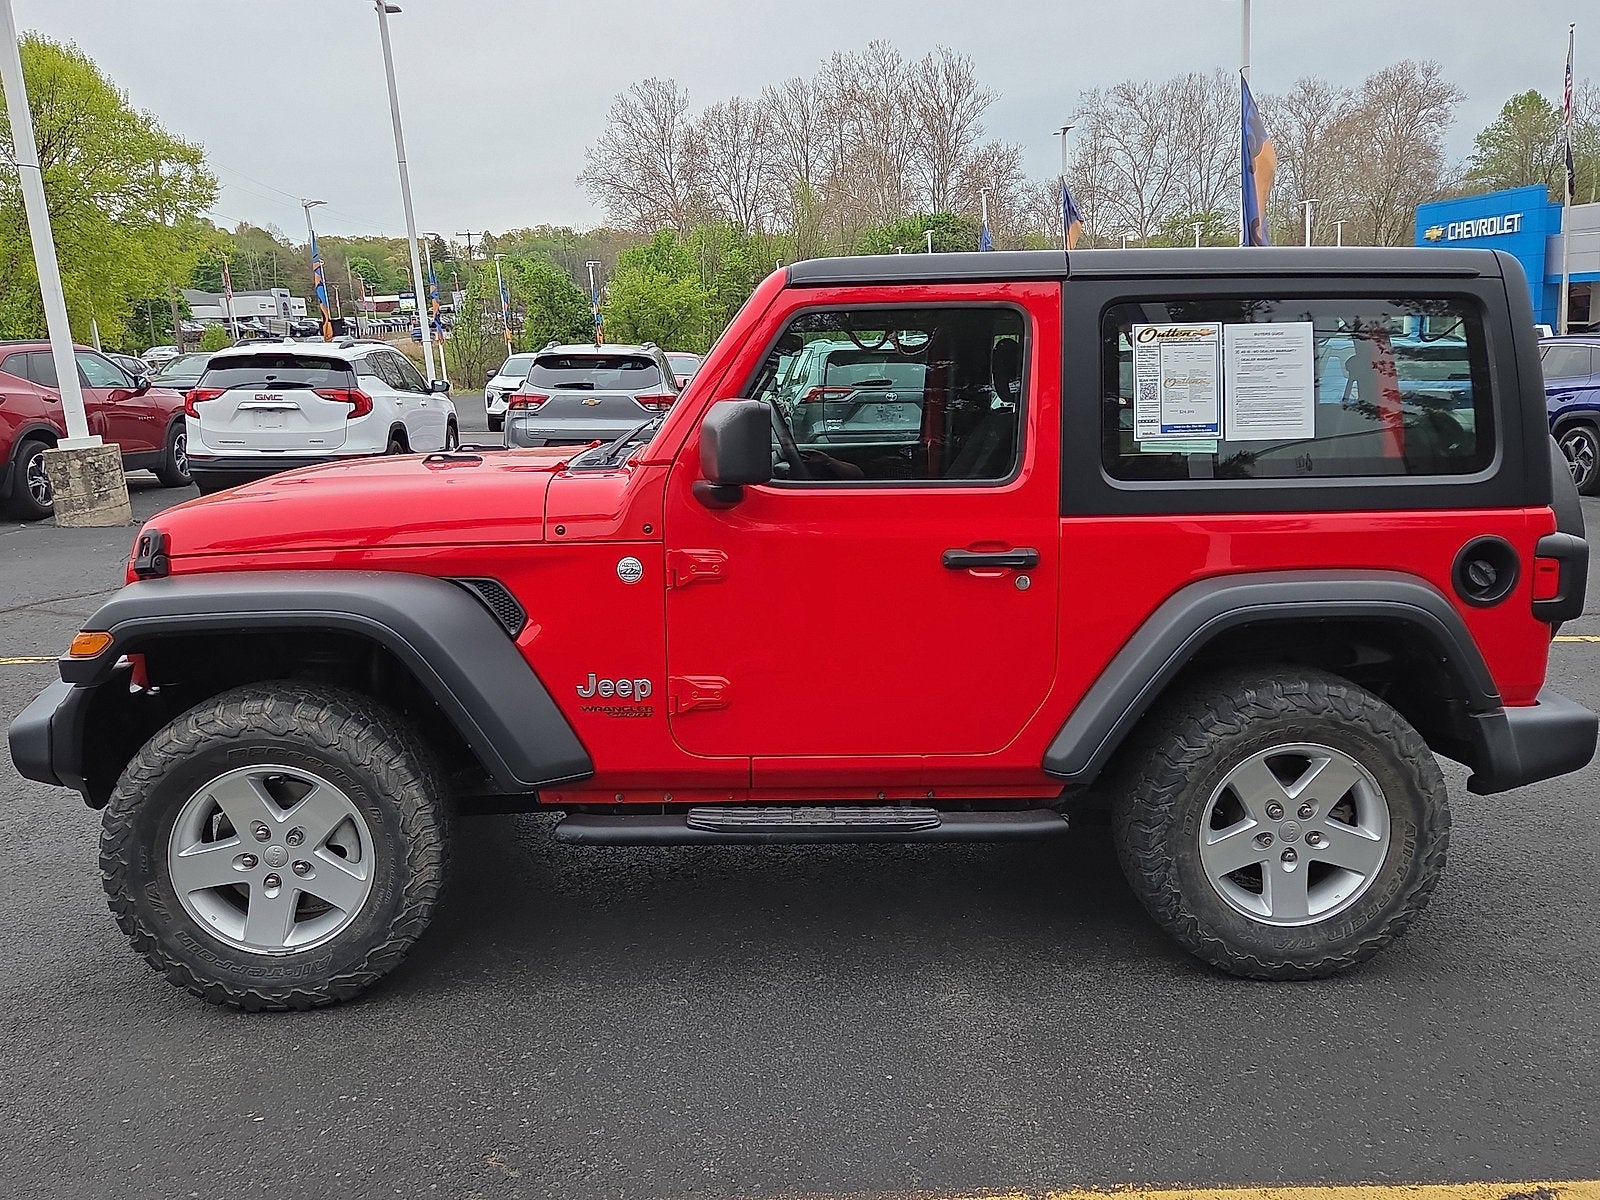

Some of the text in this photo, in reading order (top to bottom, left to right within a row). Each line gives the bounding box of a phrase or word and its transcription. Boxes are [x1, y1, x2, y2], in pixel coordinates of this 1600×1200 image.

[1447, 213, 1523, 240] CHEVROLET
[1137, 327, 1196, 343] Outten
[576, 673, 652, 701] Jeep
